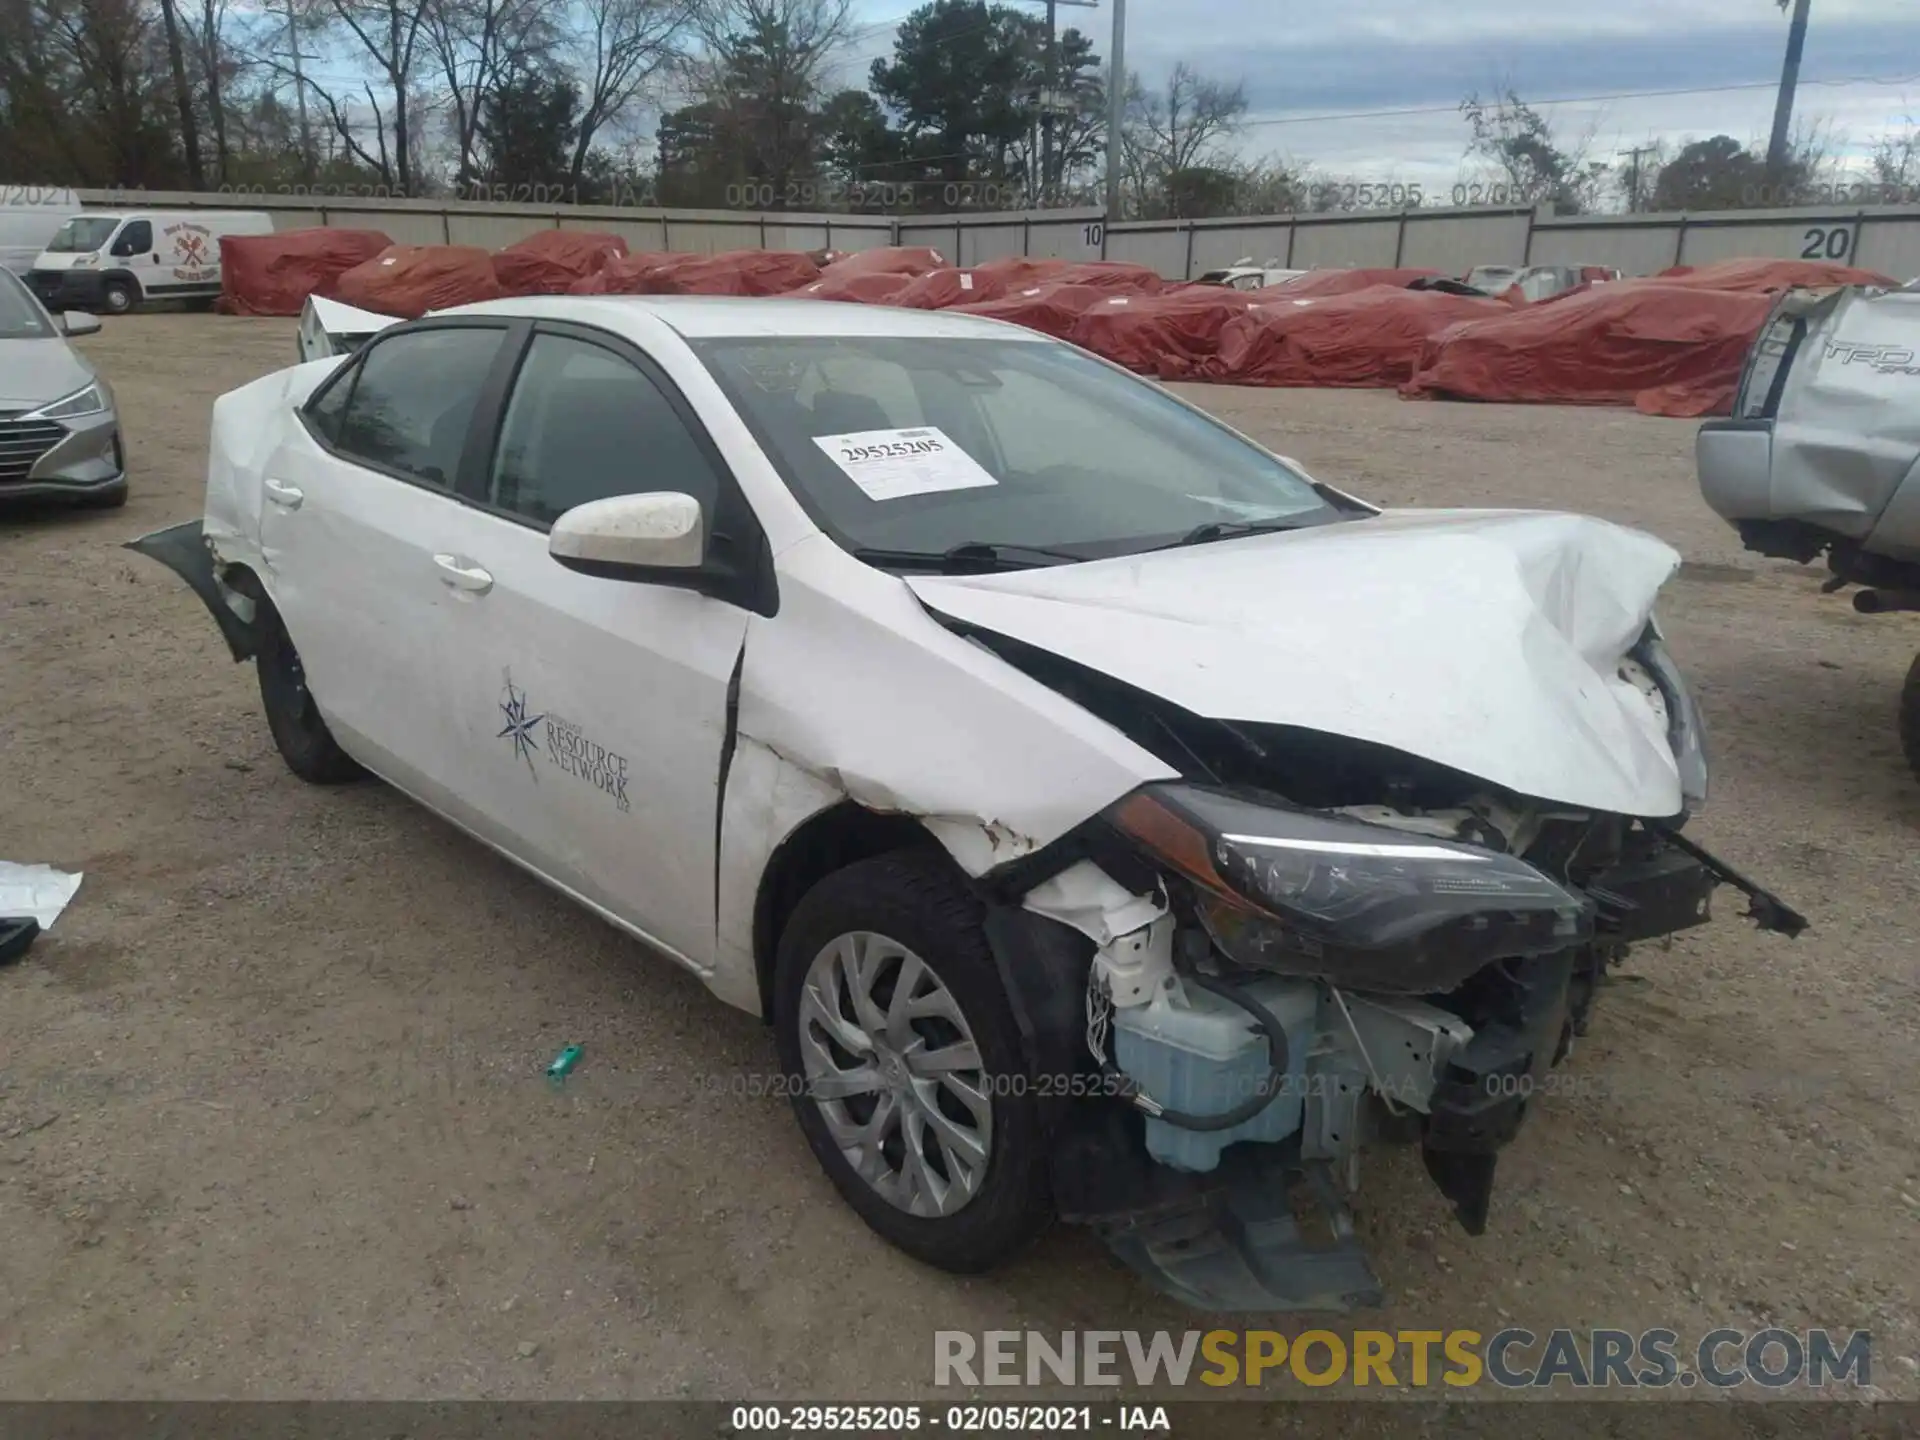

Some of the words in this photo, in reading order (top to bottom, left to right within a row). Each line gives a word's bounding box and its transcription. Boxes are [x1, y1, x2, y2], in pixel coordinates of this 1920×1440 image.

[1085, 225, 1101, 246] 10
[1801, 228, 1850, 259] 20
[1824, 340, 1914, 367] TRD
[841, 438, 944, 462] 29525205
[547, 720, 628, 780] RESOURCE
[547, 741, 629, 805] NETWORK
